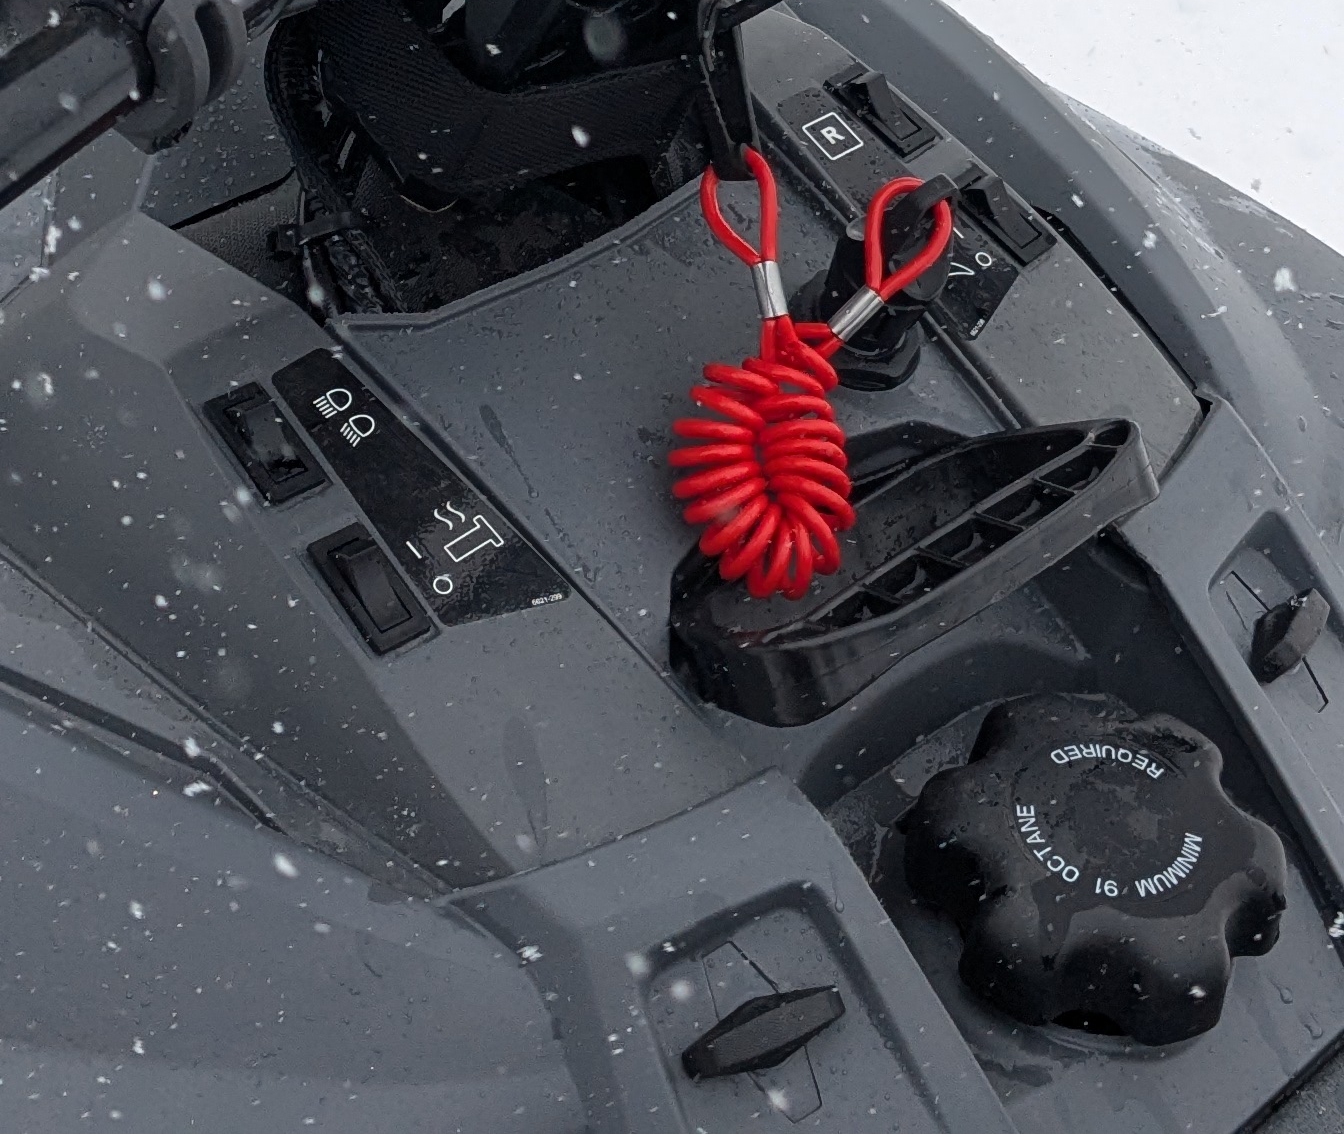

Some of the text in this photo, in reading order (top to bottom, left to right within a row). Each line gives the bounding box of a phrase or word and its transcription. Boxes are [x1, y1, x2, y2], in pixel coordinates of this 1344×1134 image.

[820, 125, 846, 145] R
[1051, 743, 1164, 779] REQUIRED
[1016, 804, 1203, 897] MINIMUM 91 OCTANE
